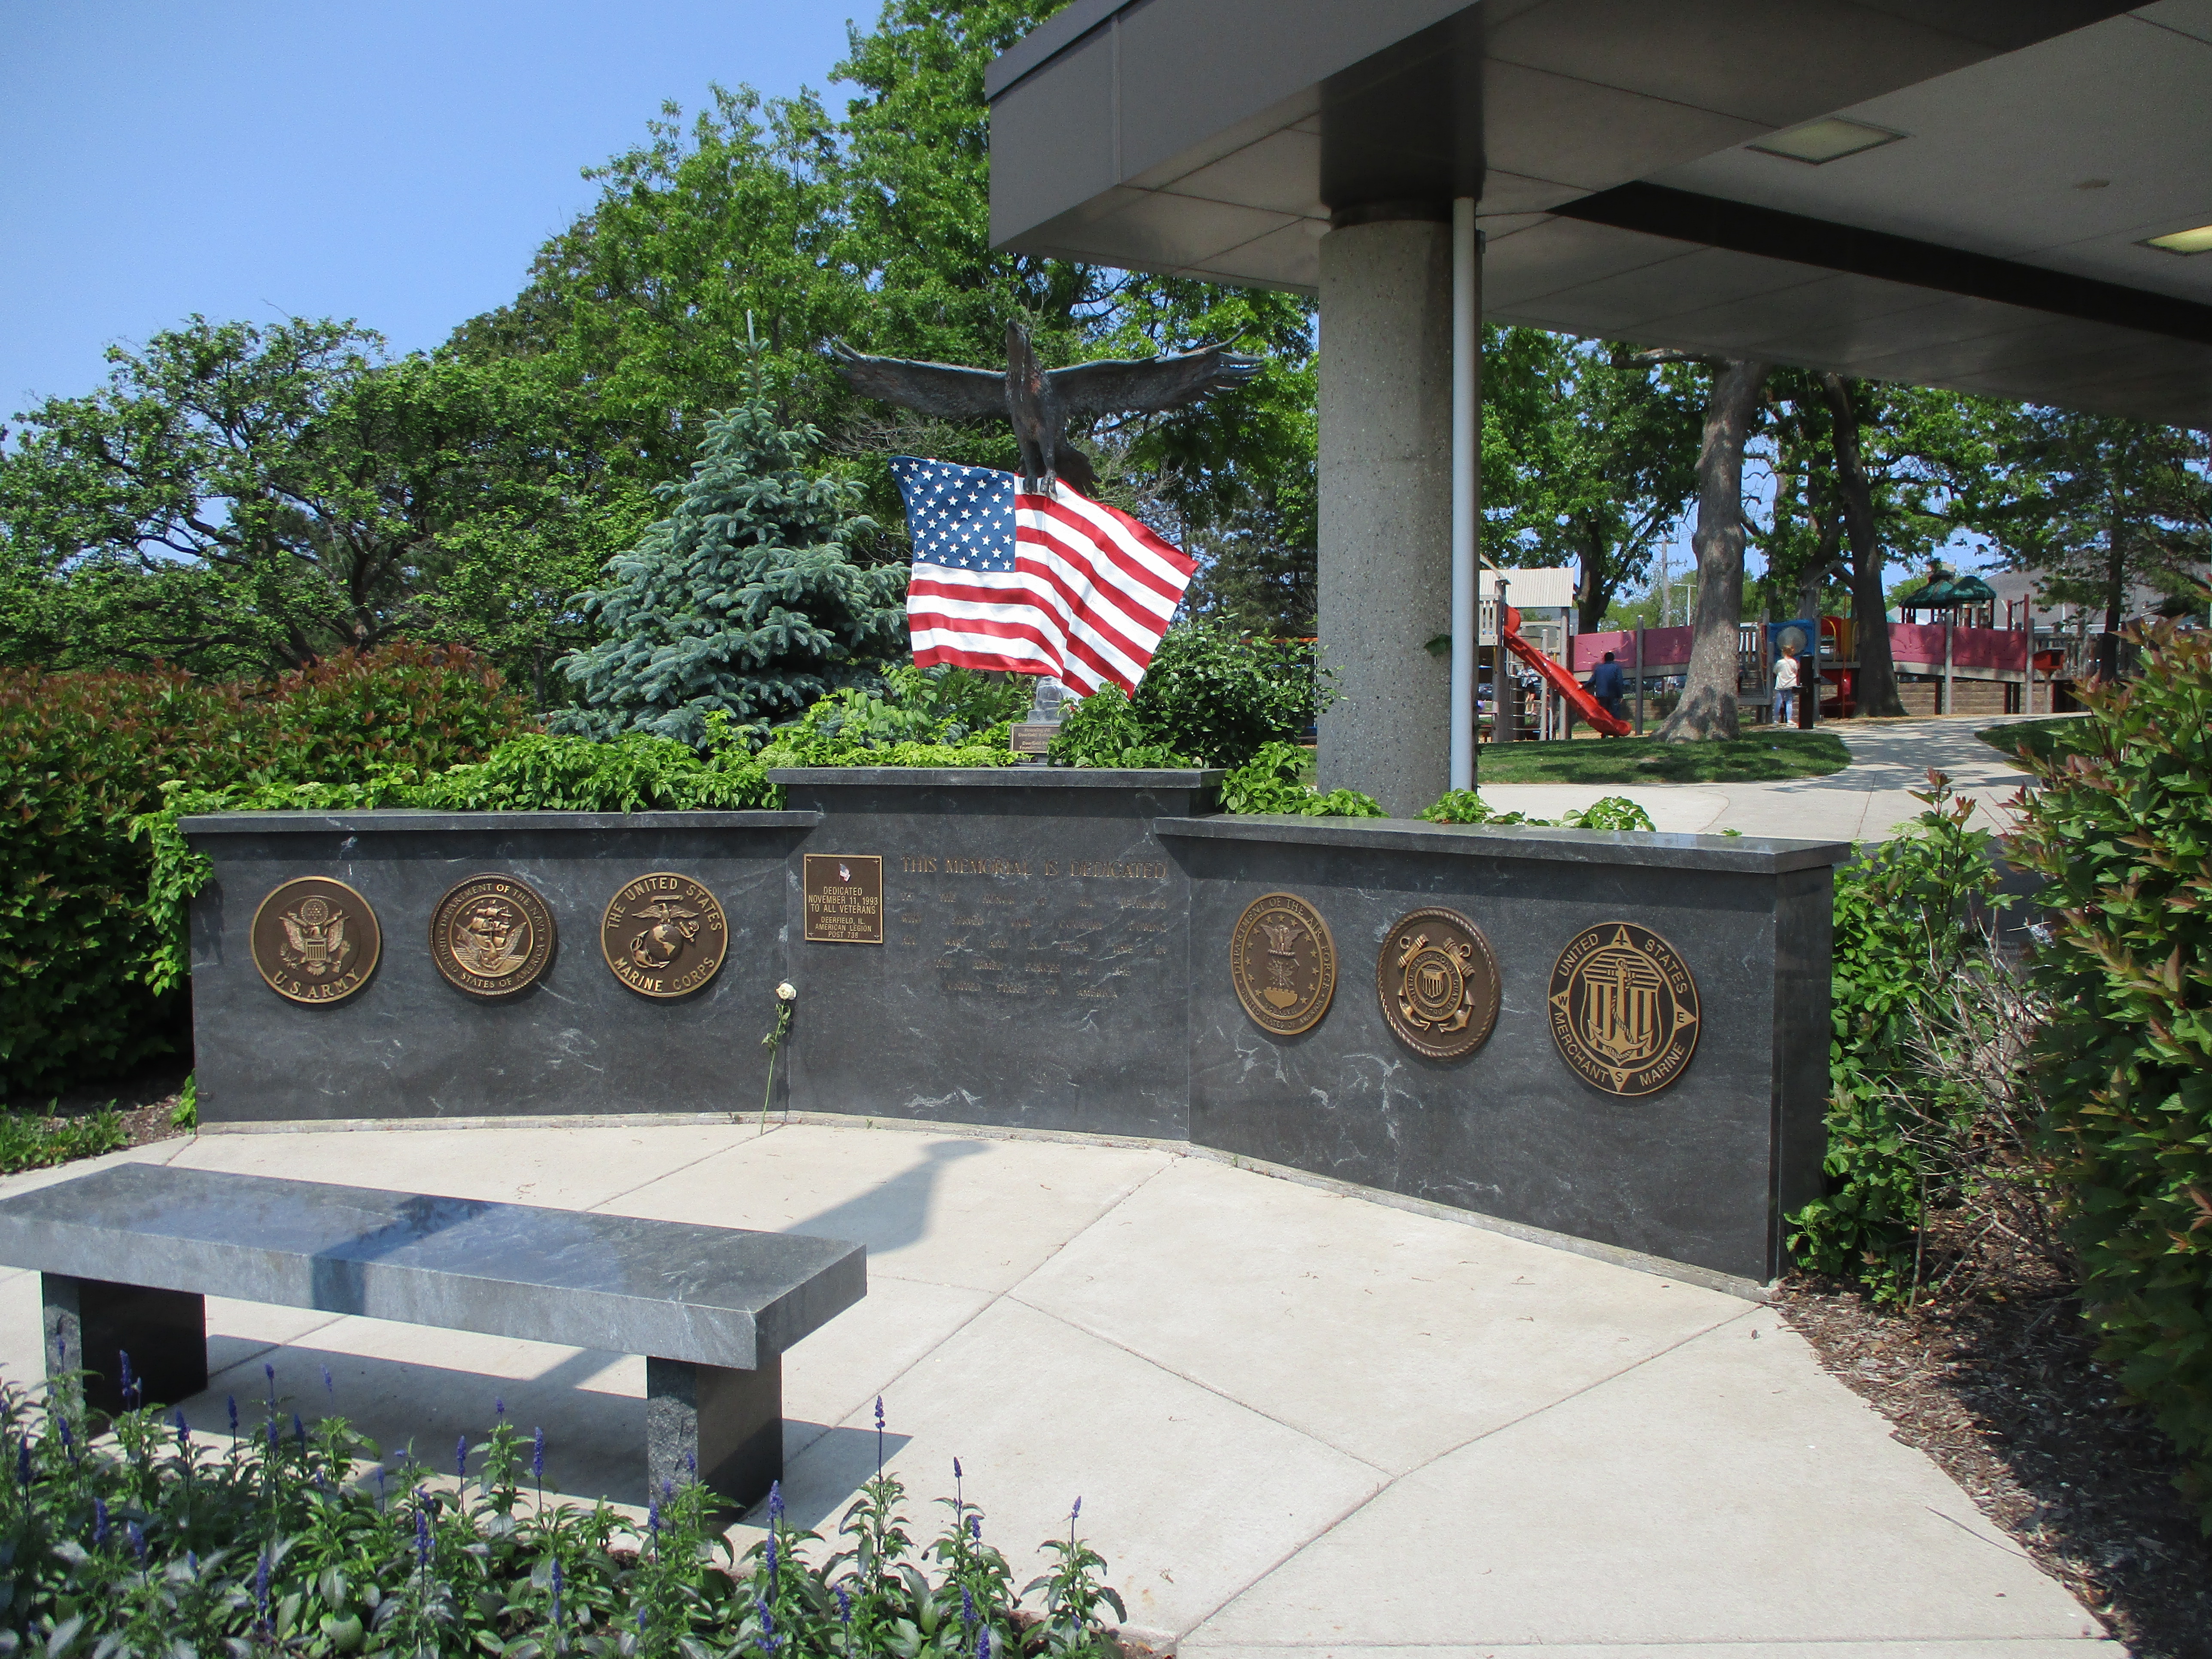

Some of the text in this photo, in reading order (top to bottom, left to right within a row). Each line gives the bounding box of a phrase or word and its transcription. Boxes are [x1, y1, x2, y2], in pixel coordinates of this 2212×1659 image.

[901, 857, 1167, 878] THIS MEMORIAL IS DEDICATED
[607, 877, 723, 931] THE UNITED STATES
[808, 895, 878, 905] NOVEMBER 11, 1993
[823, 886, 863, 896] DEDICATED
[441, 883, 545, 933] DEPARTMENT OF THE NAVY
[811, 904, 876, 914] TO ALL VETERANS
[821, 917, 855, 925] DEERFIELD,
[1233, 898, 1332, 990] DEPARTMENT OF THE AIR FORCE
[439, 938, 545, 988] UNITED STATES OF AMERICA
[614, 957, 715, 992] MARINE CORPS
[1558, 933, 1688, 994] UNITED STATES
[307, 968, 361, 998] ARMY
[1408, 952, 1459, 1009] UNITED STATES COAST GUARD
[1241, 988, 1260, 1016] UNITED
[1263, 1013, 1284, 1029] STATES
[1299, 1000, 1324, 1026] AMERICA
[1558, 995, 1568, 1006] W
[1677, 1012, 1685, 1023] E
[1554, 1012, 1686, 1086] MERCHANT MARINE
[1615, 1071, 1623, 1083] S
